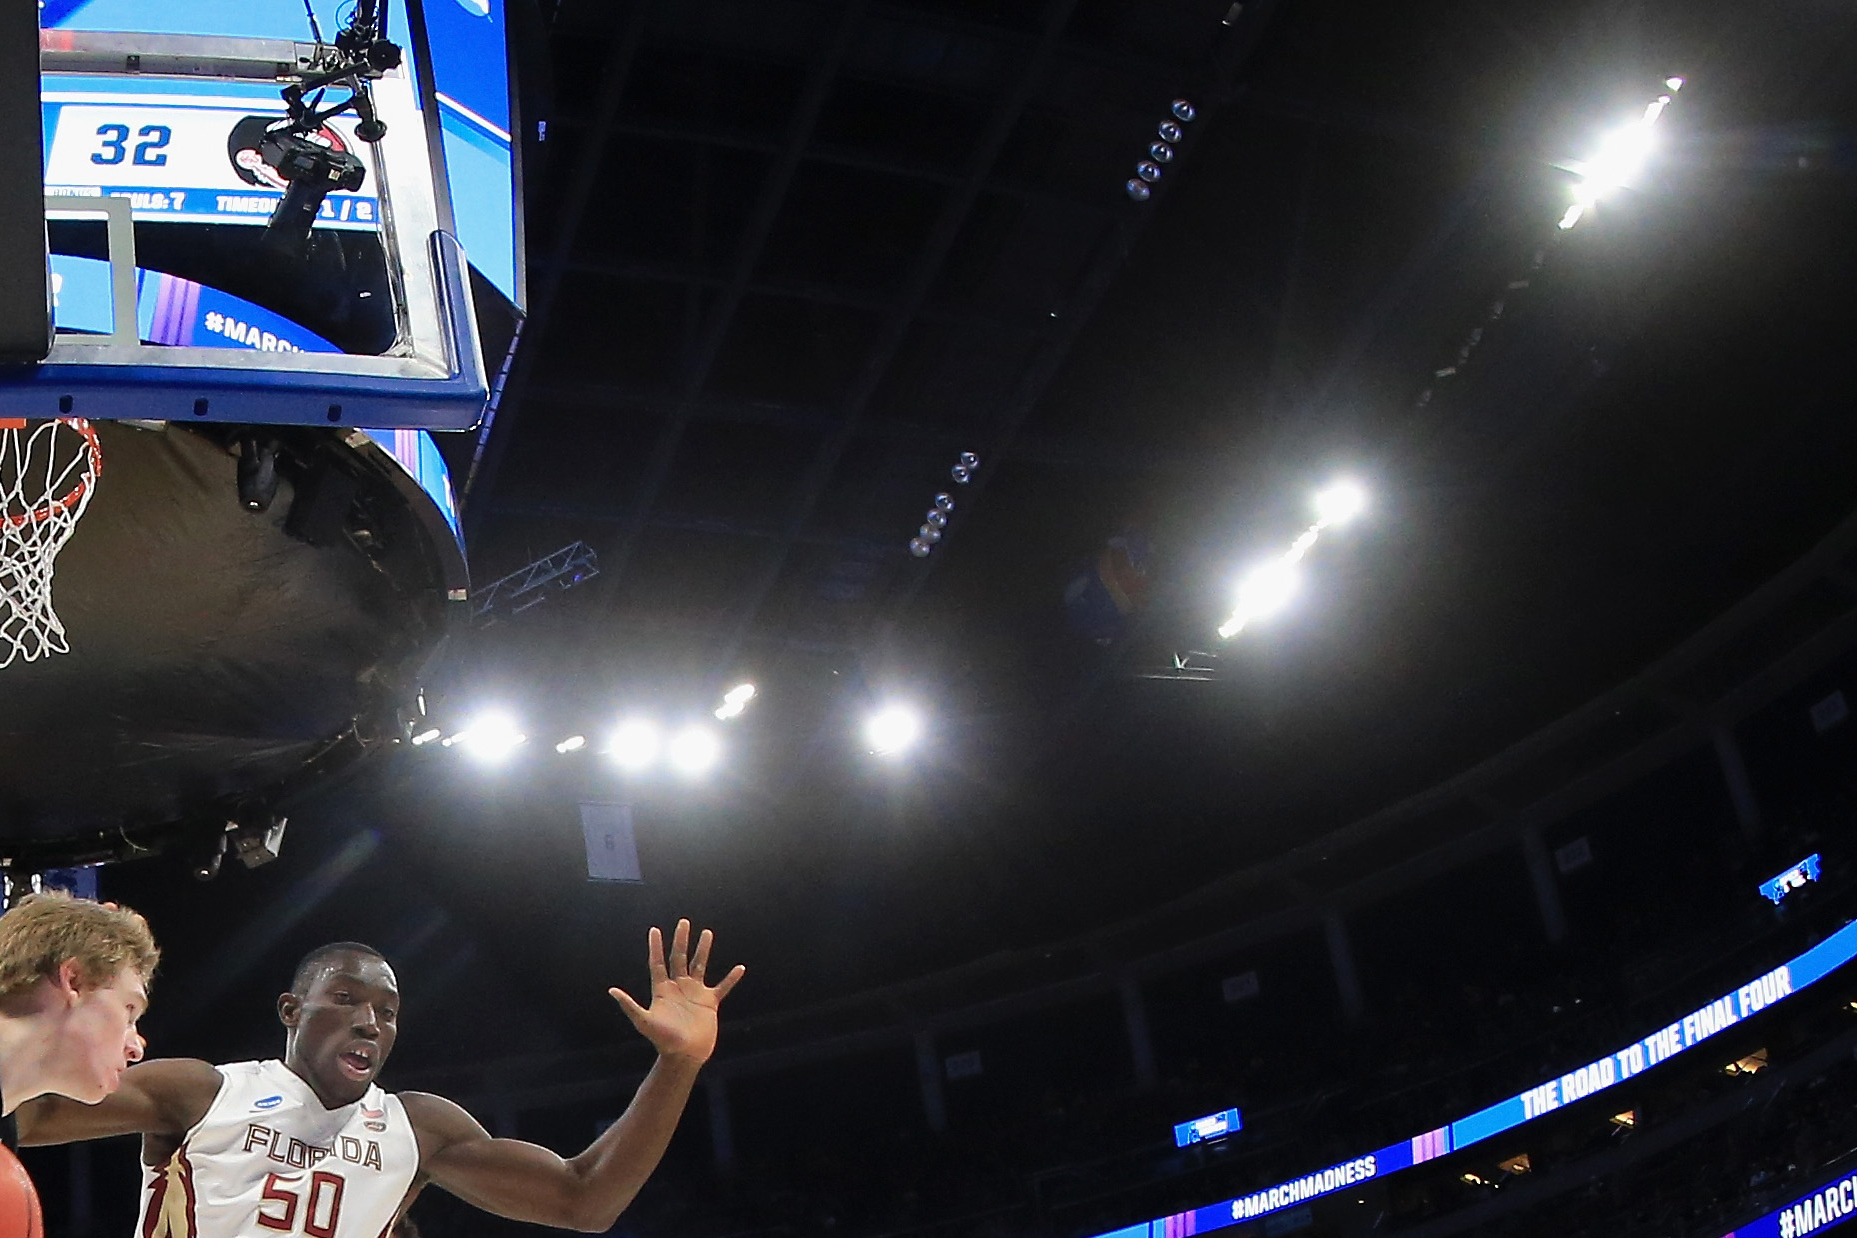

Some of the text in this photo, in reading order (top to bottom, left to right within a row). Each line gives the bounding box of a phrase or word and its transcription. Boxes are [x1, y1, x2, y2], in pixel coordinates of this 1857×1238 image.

[91, 123, 172, 167] 32
[170, 191, 187, 210] 7
[321, 200, 336, 218] 1
[1521, 965, 1794, 1120] THE ROAD TO THE FINAL FOUR
[1231, 1155, 1376, 1220] #MARCHMADNESS
